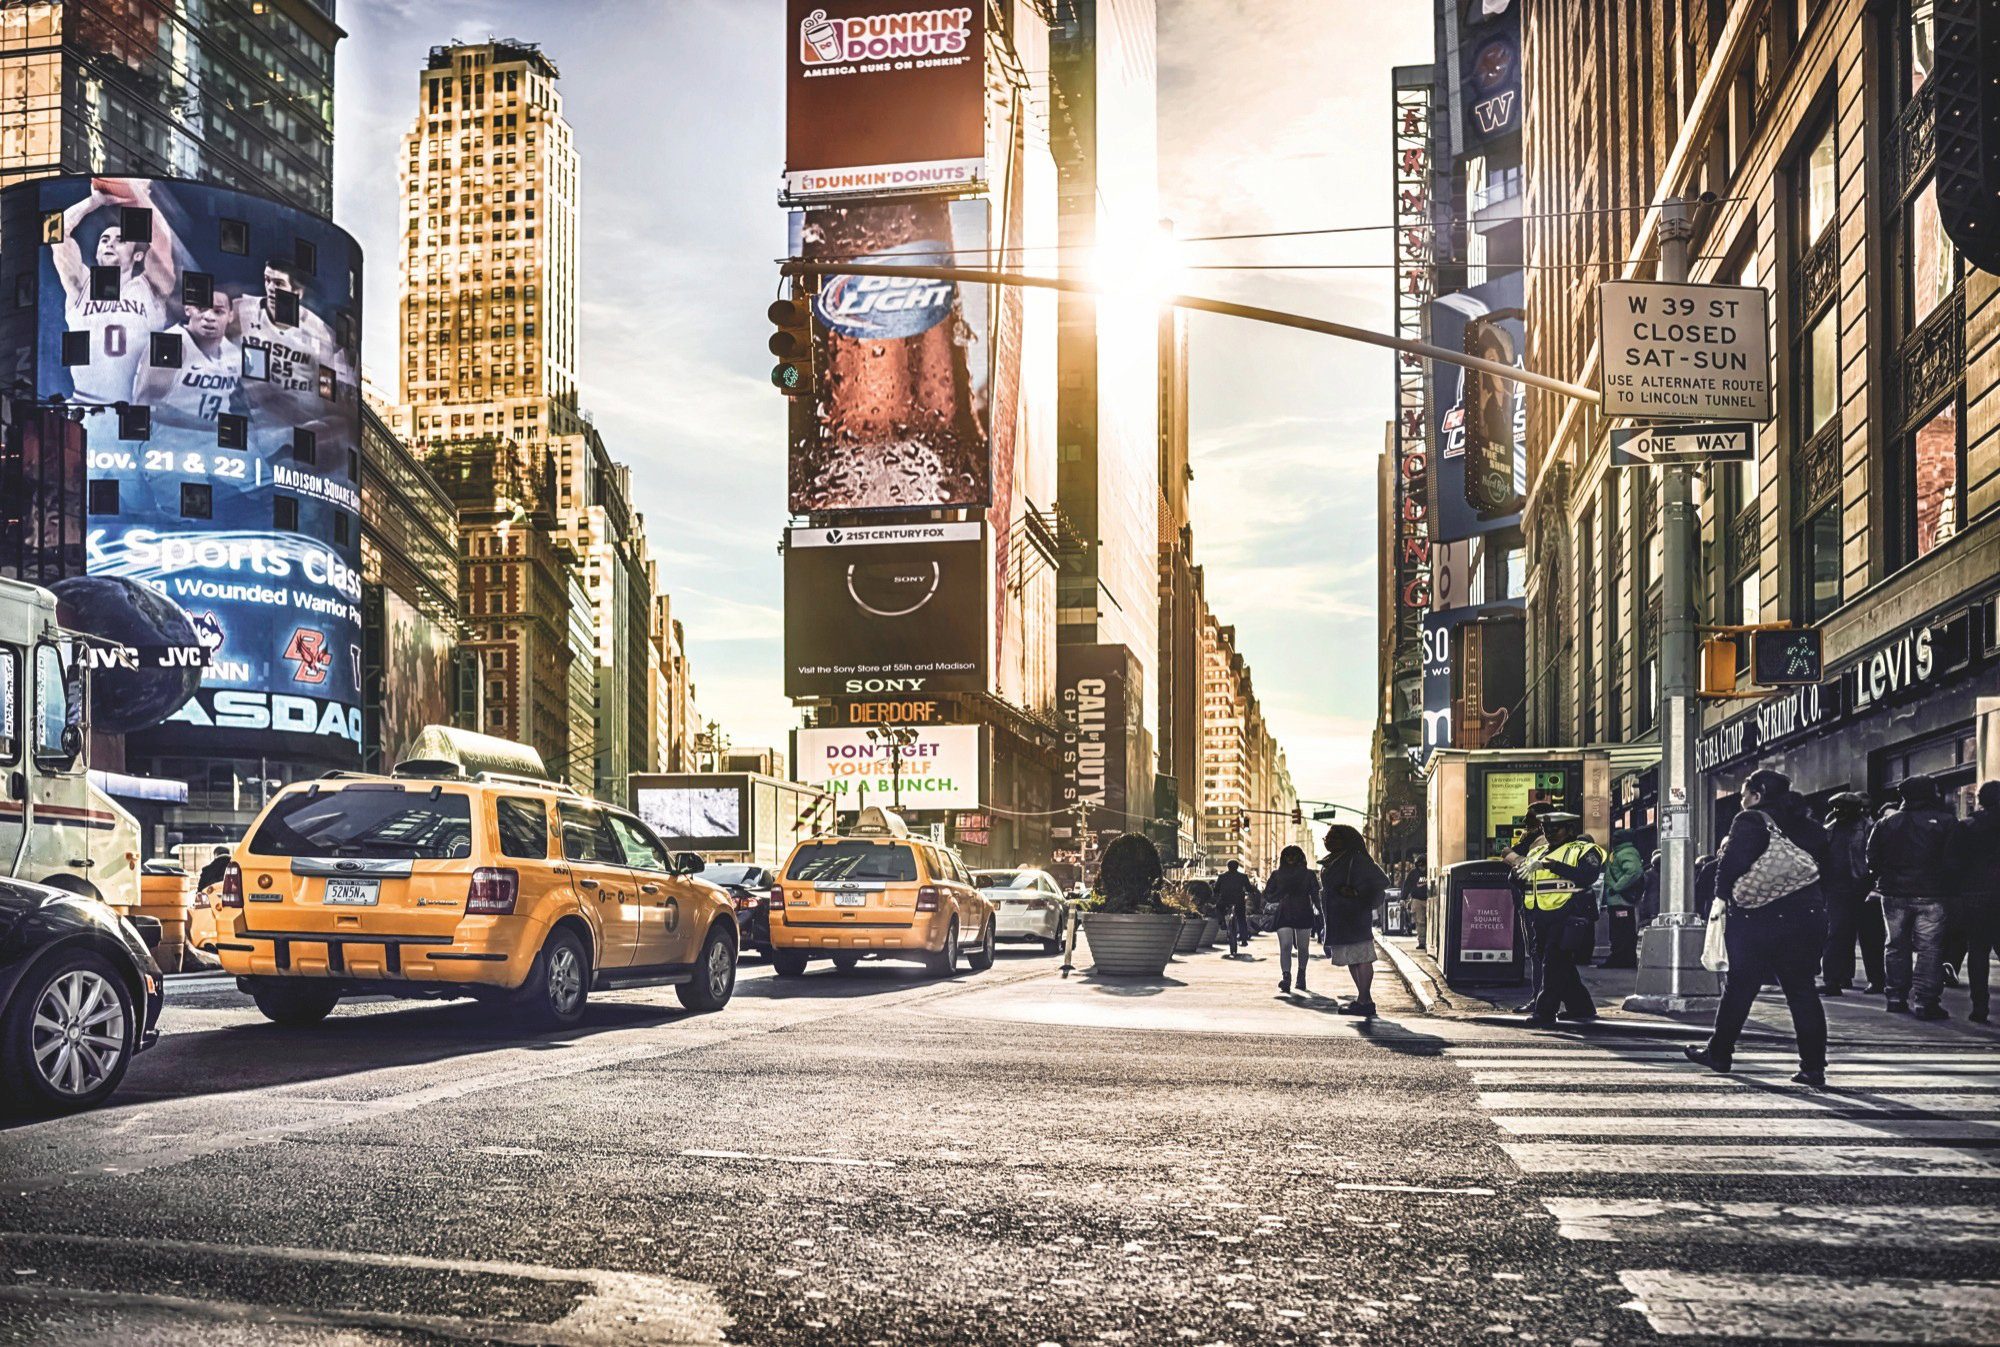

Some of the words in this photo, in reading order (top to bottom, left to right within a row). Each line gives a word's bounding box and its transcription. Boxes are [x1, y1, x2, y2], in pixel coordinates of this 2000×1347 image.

[849, 8, 972, 38] DUNKIN'
[848, 32, 963, 58] DONUTS
[803, 66, 857, 78] AMERICA
[860, 62, 891, 72] RUNS
[894, 60, 913, 71] ON
[1475, 91, 1514, 133] W
[1402, 108, 1426, 296] ERNST
[83, 299, 147, 317] INDIANA
[839, 286, 952, 315] LIGHT
[1628, 296, 1648, 314] W
[1662, 298, 1695, 316] 39
[1709, 300, 1739, 319] ST
[1633, 322, 1737, 345] CLOSED
[1625, 348, 1747, 371] SAT-SUN
[182, 372, 240, 391] UCONN
[1608, 375, 1634, 387] USE
[1641, 376, 1716, 392] ALTERNATE
[1722, 379, 1764, 392] ROUTE
[1617, 391, 1634, 402] TO
[1641, 392, 1699, 406] LINCOLN
[1704, 394, 1757, 408] TUNNEL
[1481, 447, 1498, 460] THE
[1488, 441, 1506, 455] SEE
[1637, 438, 1676, 453] ONE
[1696, 434, 1738, 450] WAY
[144, 450, 174, 471] 21
[182, 452, 206, 474] &
[214, 456, 246, 479] 22
[1402, 409, 1431, 608] YOUNG
[846, 531, 870, 541] 21ST
[870, 529, 923, 540] CENTURY
[923, 528, 945, 537] FOX
[123, 528, 292, 577] Sports
[893, 575, 927, 583] SONY
[1439, 543, 1450, 611] CO
[175, 578, 288, 606] Wounded
[292, 590, 347, 618] Warrior
[158, 647, 201, 667] JVC
[798, 665, 815, 674] Visit
[817, 665, 832, 674] the
[833, 665, 855, 675] Sony
[857, 664, 881, 673] Store
[882, 663, 892, 672] at
[893, 663, 913, 672] 55th
[914, 663, 934, 672] and
[935, 661, 976, 671] Madison
[845, 678, 927, 694] SONY
[1077, 678, 1106, 735] CALL
[159, 691, 362, 754] ASDAQ
[826, 744, 892, 760] DON'T
[902, 743, 940, 758] GET
[1064, 688, 1076, 800] GHOSTS
[827, 761, 932, 777] YOURSELF
[1077, 741, 1106, 806] DUTY
[826, 780, 849, 793] IN
[859, 779, 870, 792] A
[877, 777, 959, 793] BUNCH.
